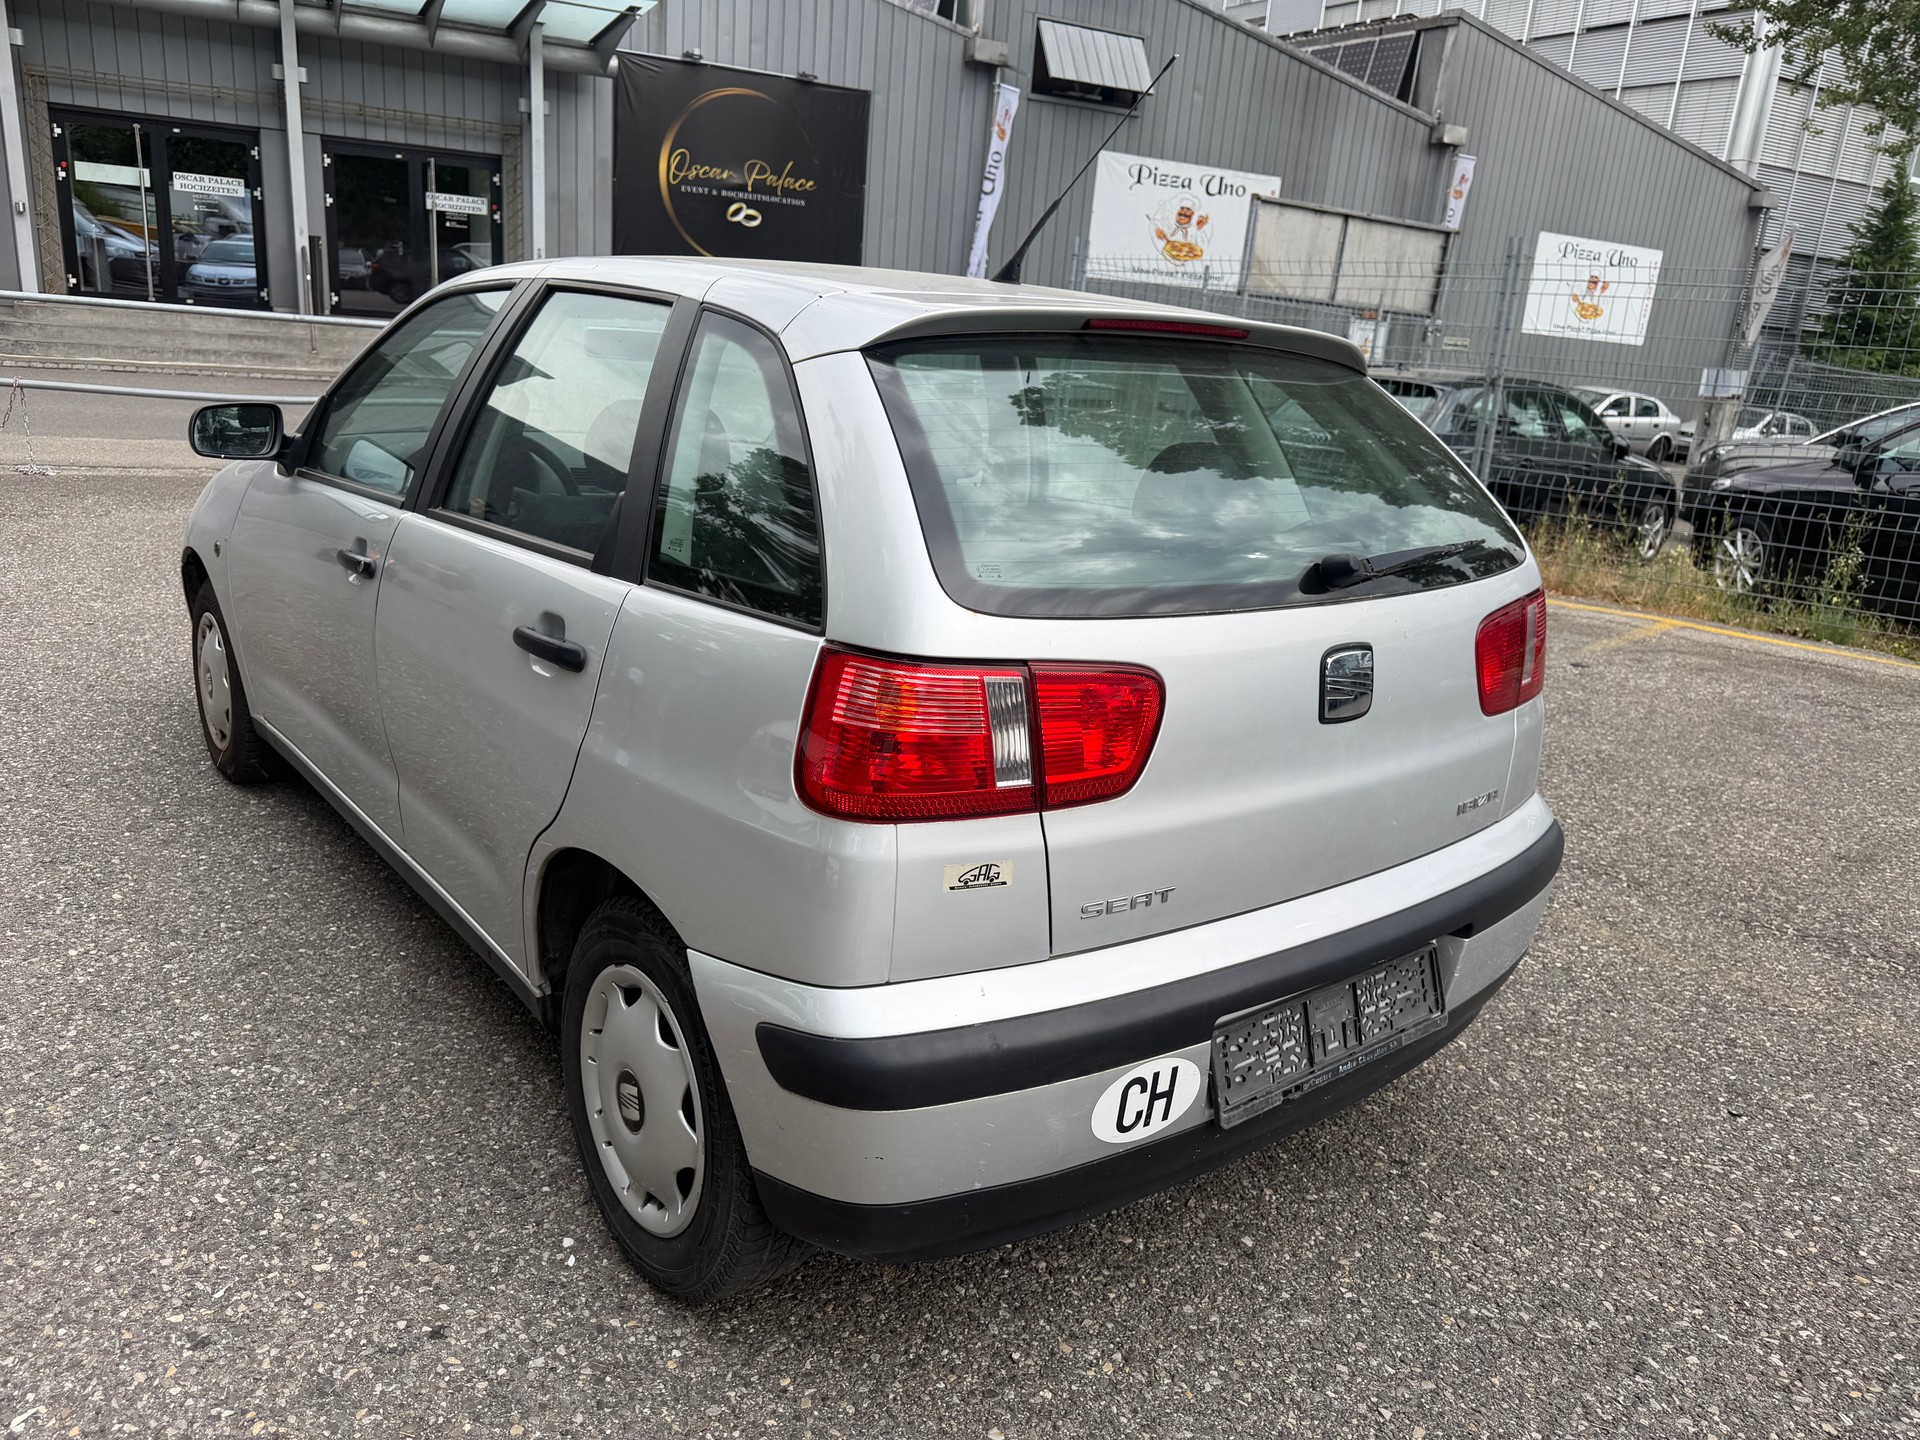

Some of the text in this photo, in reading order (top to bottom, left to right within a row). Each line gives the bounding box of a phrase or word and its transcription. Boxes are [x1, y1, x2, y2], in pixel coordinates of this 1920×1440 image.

[174, 173, 244, 187] OSCAR PALACE
[669, 148, 817, 196] Oscar Palace
[1128, 163, 1247, 197] Pizza Uno
[180, 183, 239, 195] HOCHZEITEN
[680, 184, 709, 195] EVENT
[721, 189, 806, 207] HOCHZEITSLOCATION
[1558, 241, 1638, 268] Pizza Uno
[958, 863, 1001, 883] GAG
[1080, 885, 1177, 920] SEAT
[1115, 1065, 1180, 1134] CH
